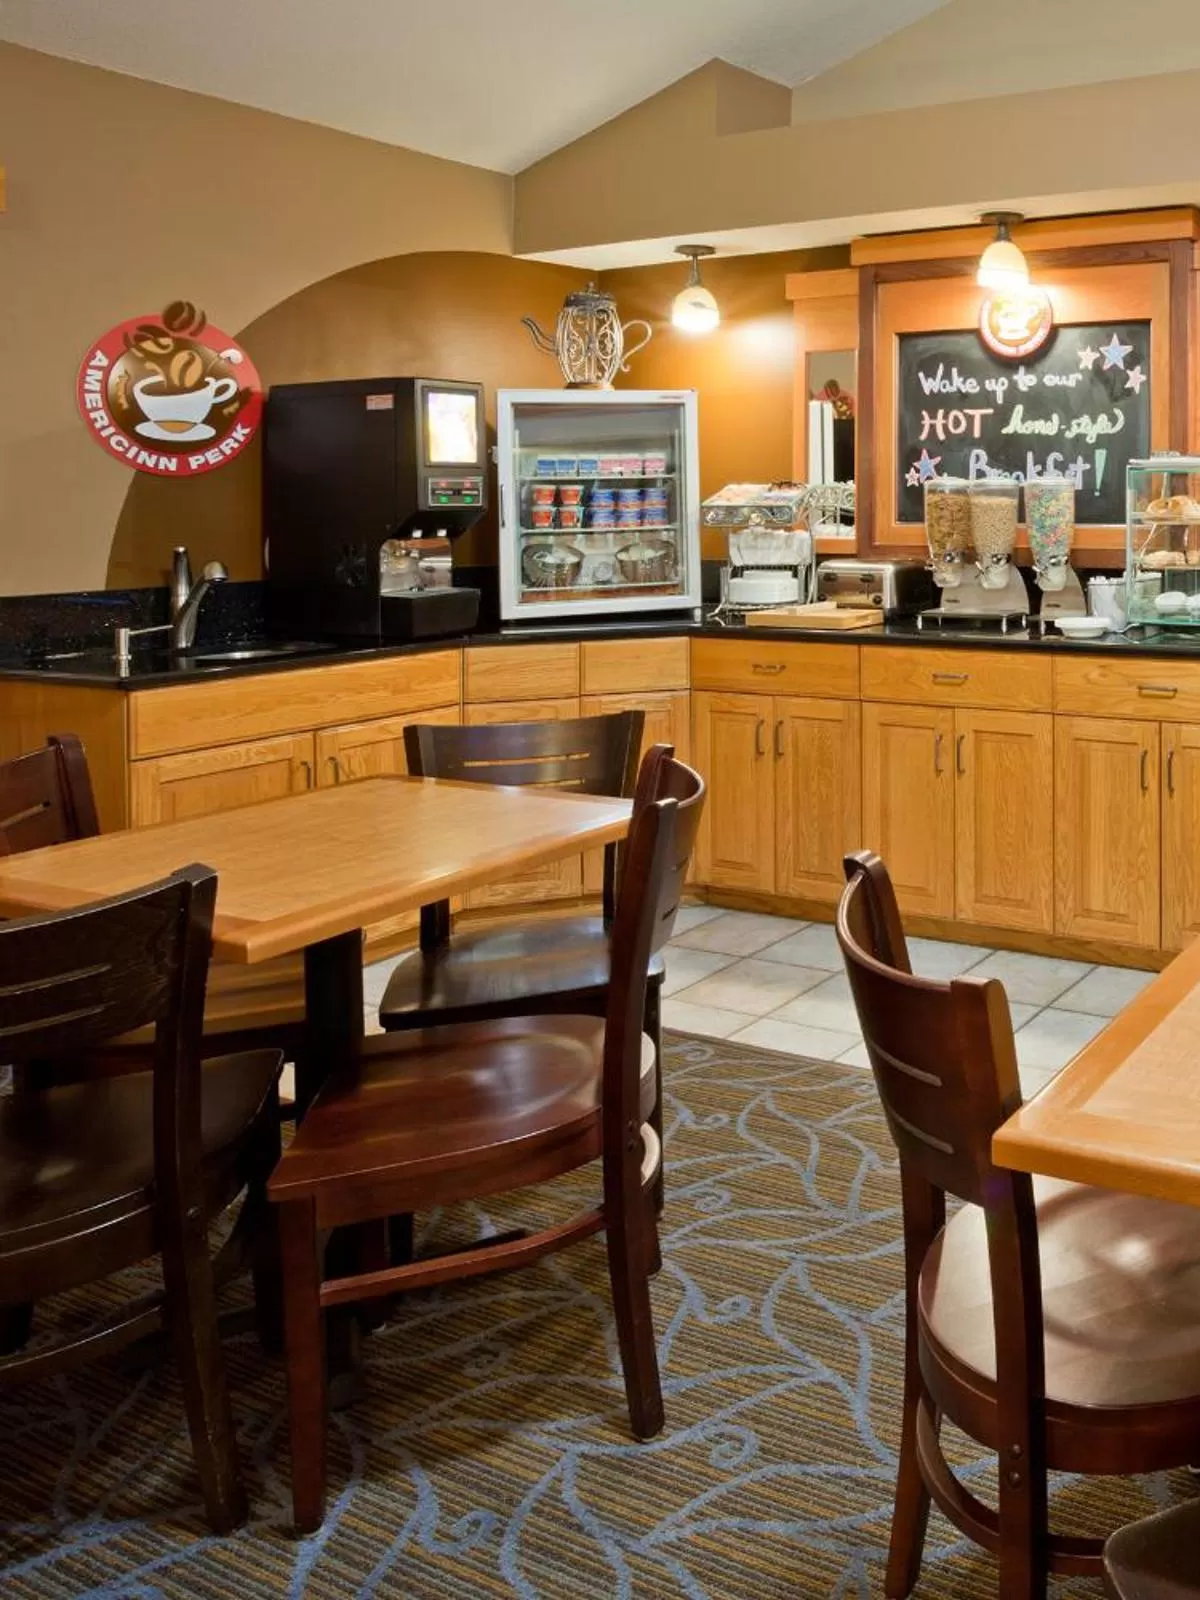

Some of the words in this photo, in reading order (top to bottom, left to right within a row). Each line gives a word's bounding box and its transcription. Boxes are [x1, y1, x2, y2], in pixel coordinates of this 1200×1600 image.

[918, 363, 980, 395] Wake
[984, 378, 1008, 404] up
[1013, 365, 1037, 392] to
[1043, 372, 1083, 388] our
[84, 350, 178, 472] AMERICINN
[188, 423, 251, 470] PERK
[918, 408, 994, 441] HOT
